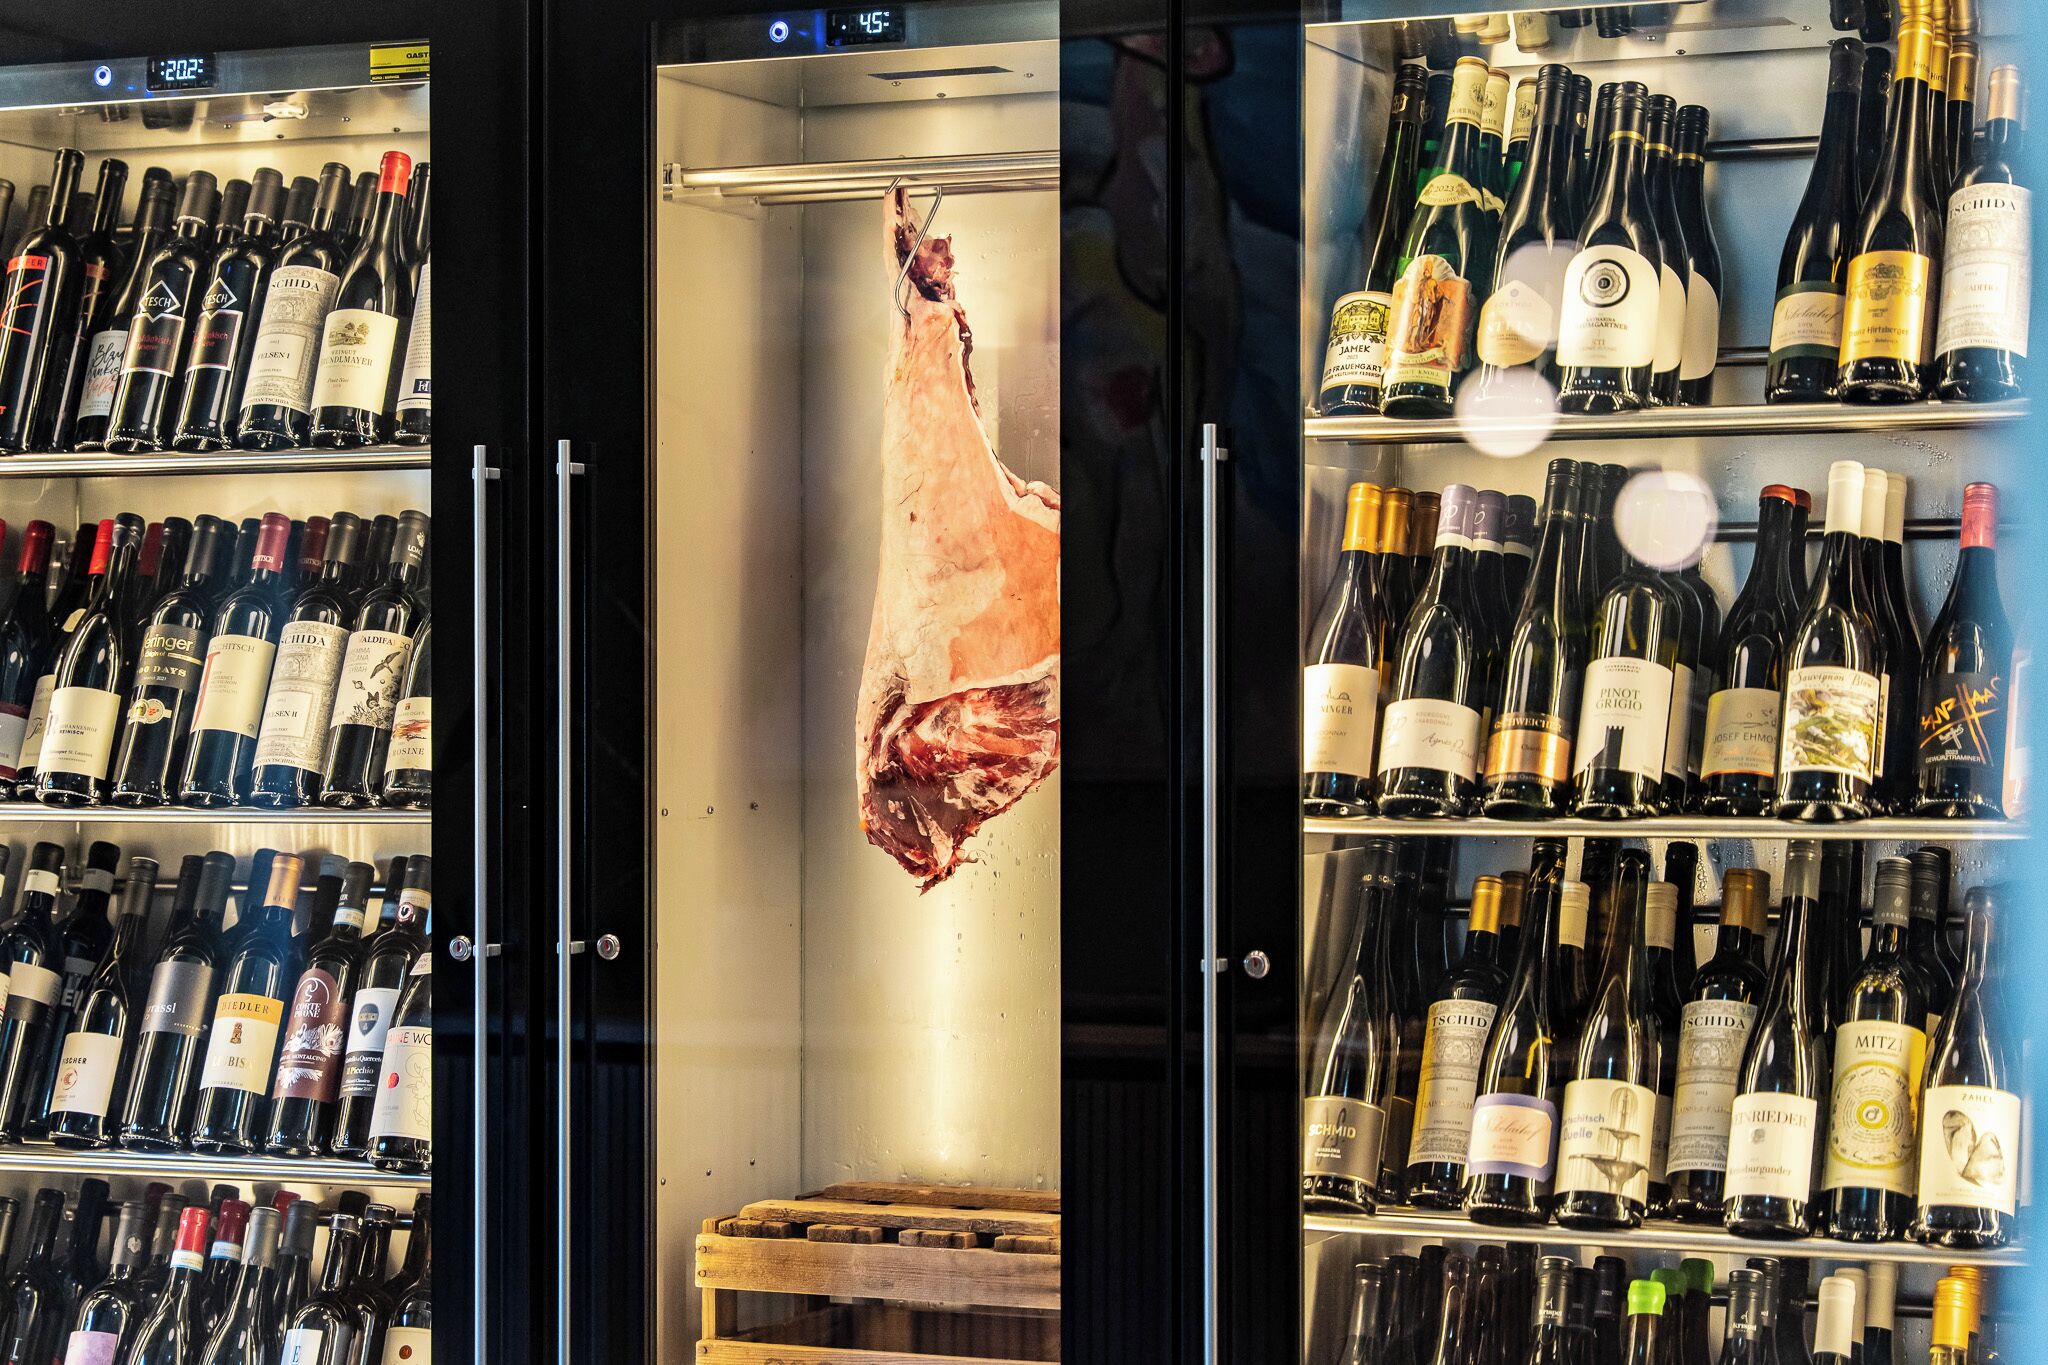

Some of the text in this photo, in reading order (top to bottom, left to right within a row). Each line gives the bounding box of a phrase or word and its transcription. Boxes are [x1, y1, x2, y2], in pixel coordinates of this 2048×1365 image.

[1433, 185, 1455, 193] 2023
[145, 296, 172, 308] TESCH
[1339, 344, 1371, 356] JAMEK
[144, 632, 194, 652] eringer
[152, 665, 187, 678] DAYS
[1599, 688, 1640, 700] PINOT
[1595, 700, 1643, 712] GRIGIO
[1713, 733, 1740, 745] JOSEF
[1682, 1015, 1747, 1030] TSCHIDA
[1855, 1035, 1903, 1052] MITZI
[1308, 1124, 1357, 1140] SCHMID
